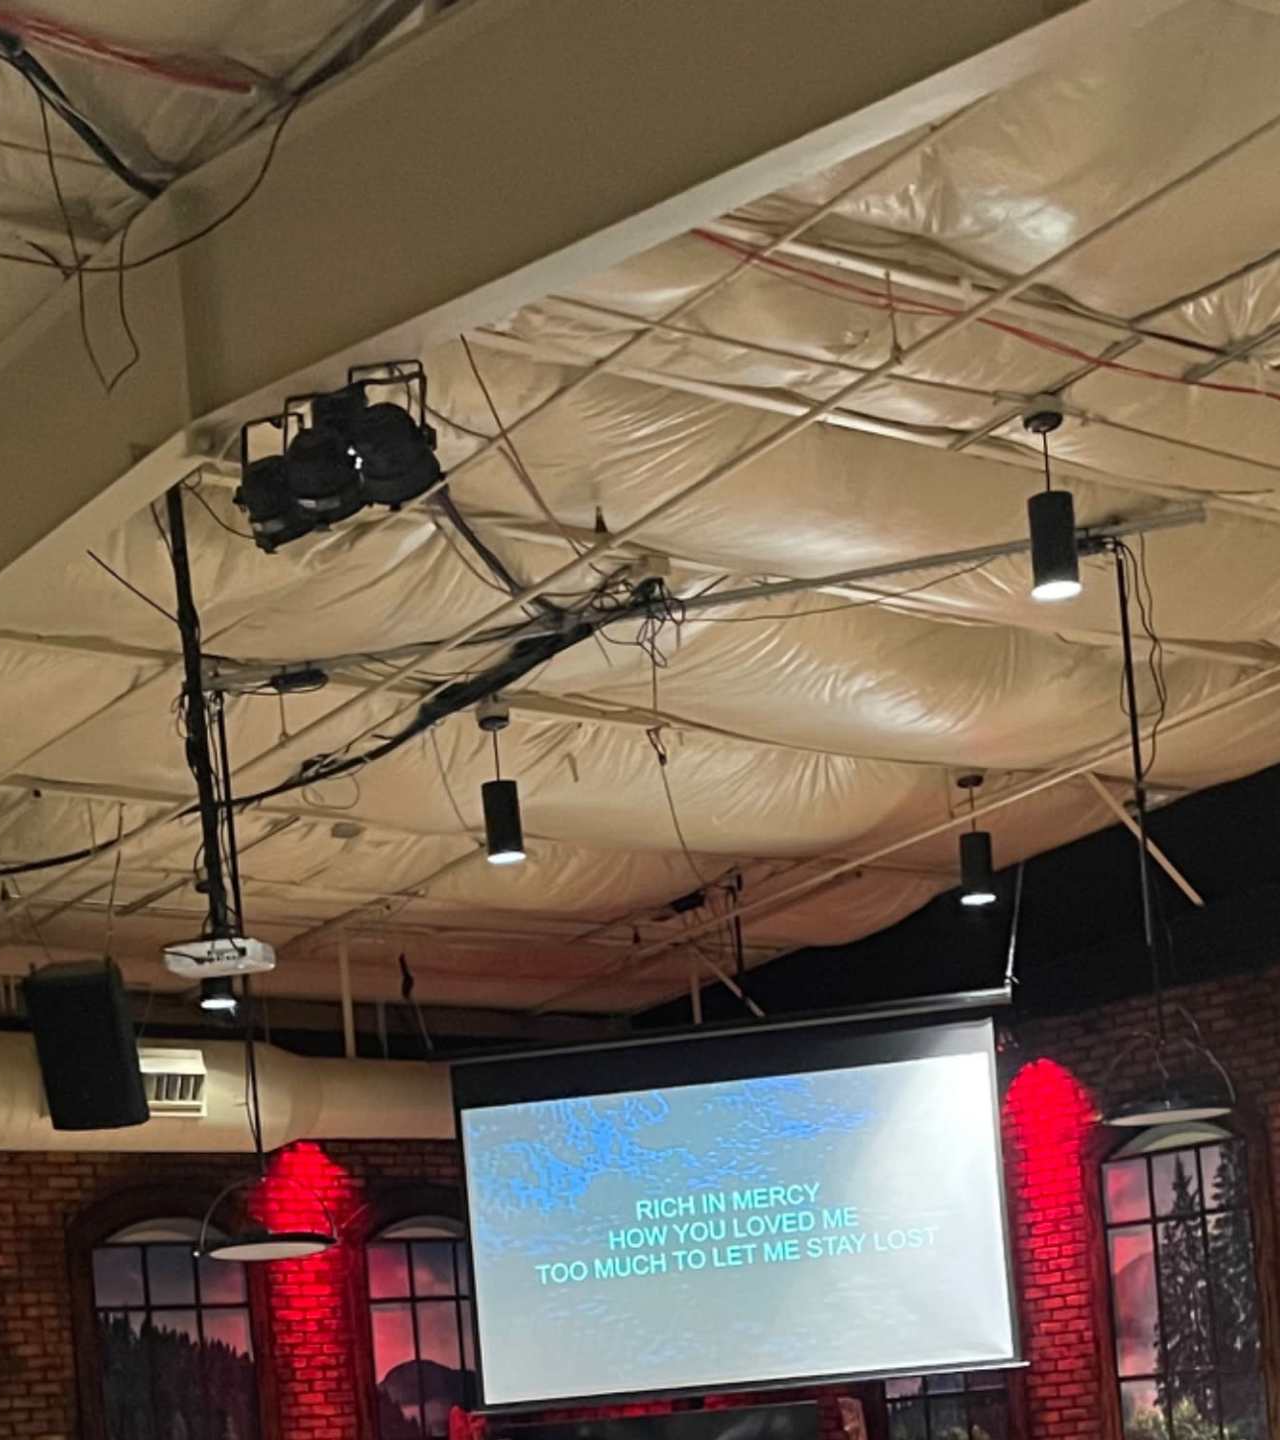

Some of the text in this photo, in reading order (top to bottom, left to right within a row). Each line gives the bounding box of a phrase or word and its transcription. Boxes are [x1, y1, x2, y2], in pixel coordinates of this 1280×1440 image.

[636, 1182, 820, 1221] RICH IN MERCY
[608, 1206, 859, 1250] HOW YOU LOVED ME
[535, 1224, 939, 1285] TOO MUCH TO LET ME STAY LOST
